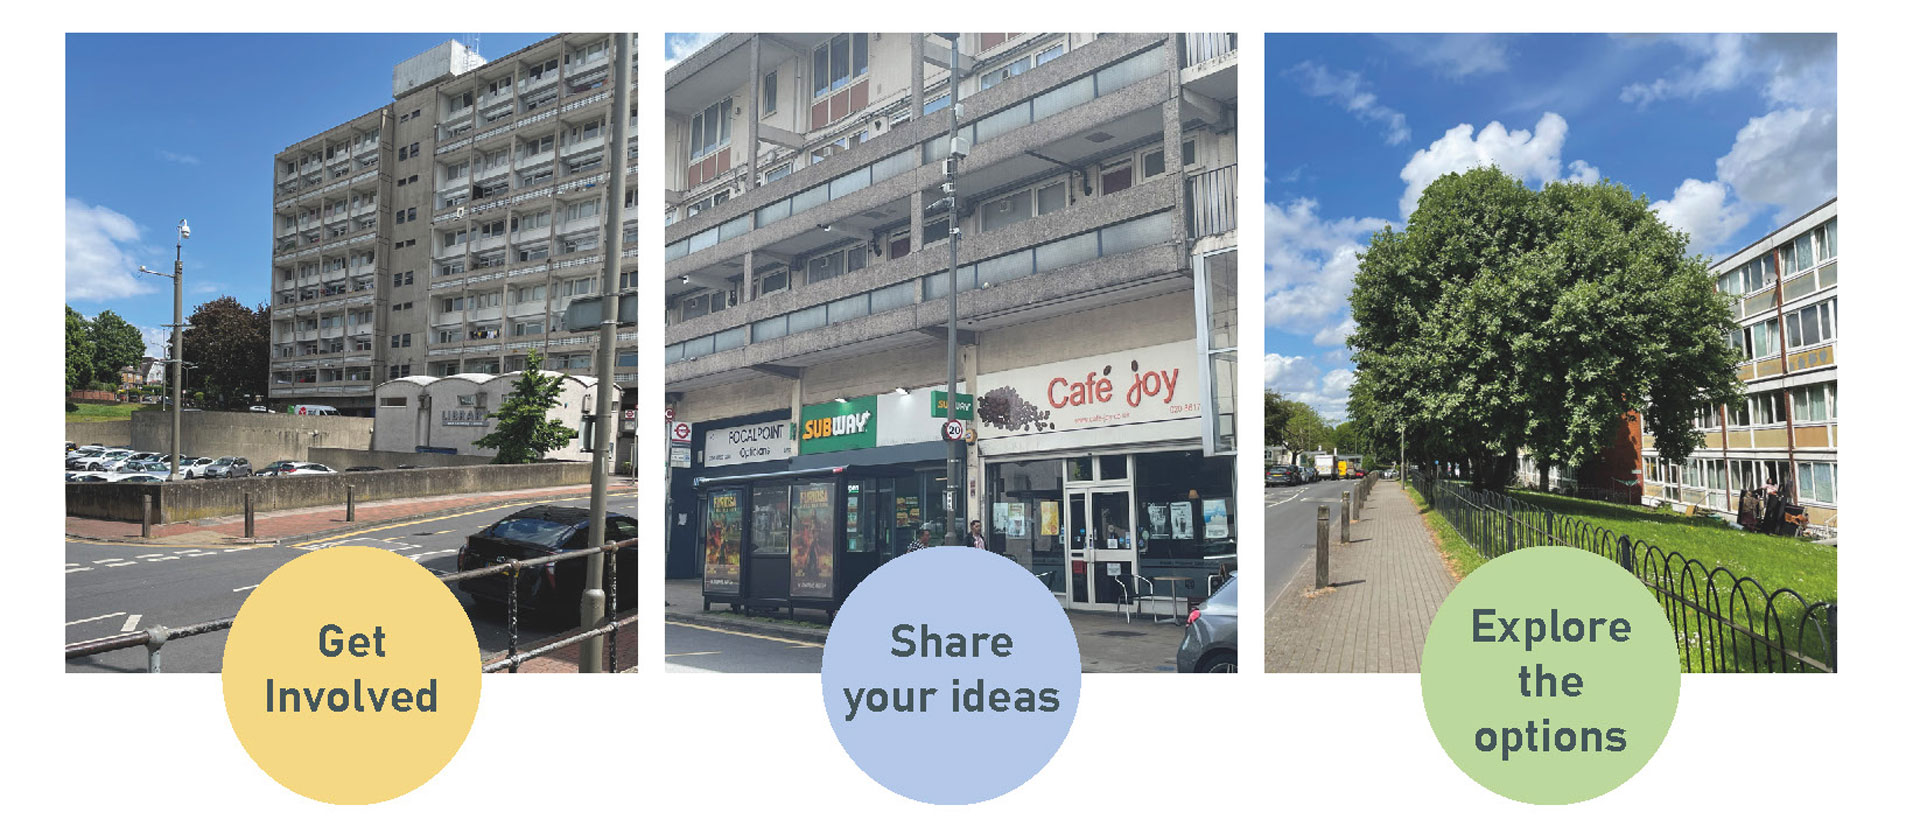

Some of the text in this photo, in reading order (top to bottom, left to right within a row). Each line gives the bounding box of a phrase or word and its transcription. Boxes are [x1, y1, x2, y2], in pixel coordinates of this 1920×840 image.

[1047, 360, 1179, 409] Café joy
[802, 411, 871, 440] SUBWAY
[949, 425, 961, 435] 20
